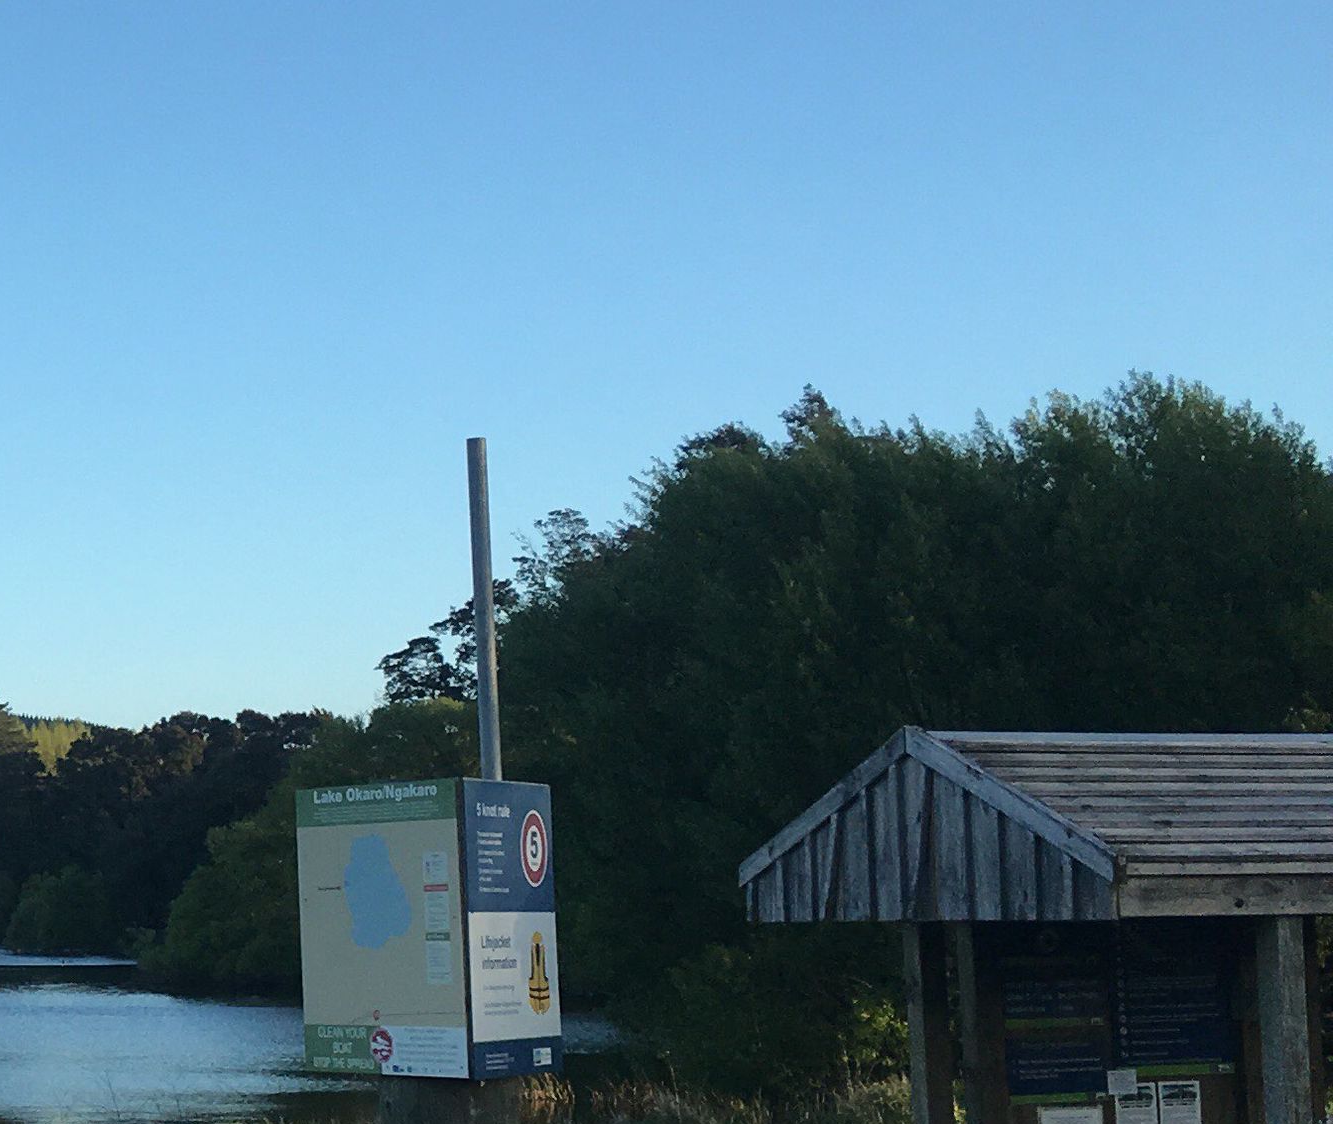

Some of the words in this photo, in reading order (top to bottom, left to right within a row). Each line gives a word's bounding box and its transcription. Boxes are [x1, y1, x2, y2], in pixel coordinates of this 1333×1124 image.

[313, 790, 343, 804] Lake
[476, 802, 482, 817] 5
[482, 803, 497, 817] knot
[498, 804, 510, 818] rule
[530, 831, 538, 859] 5
